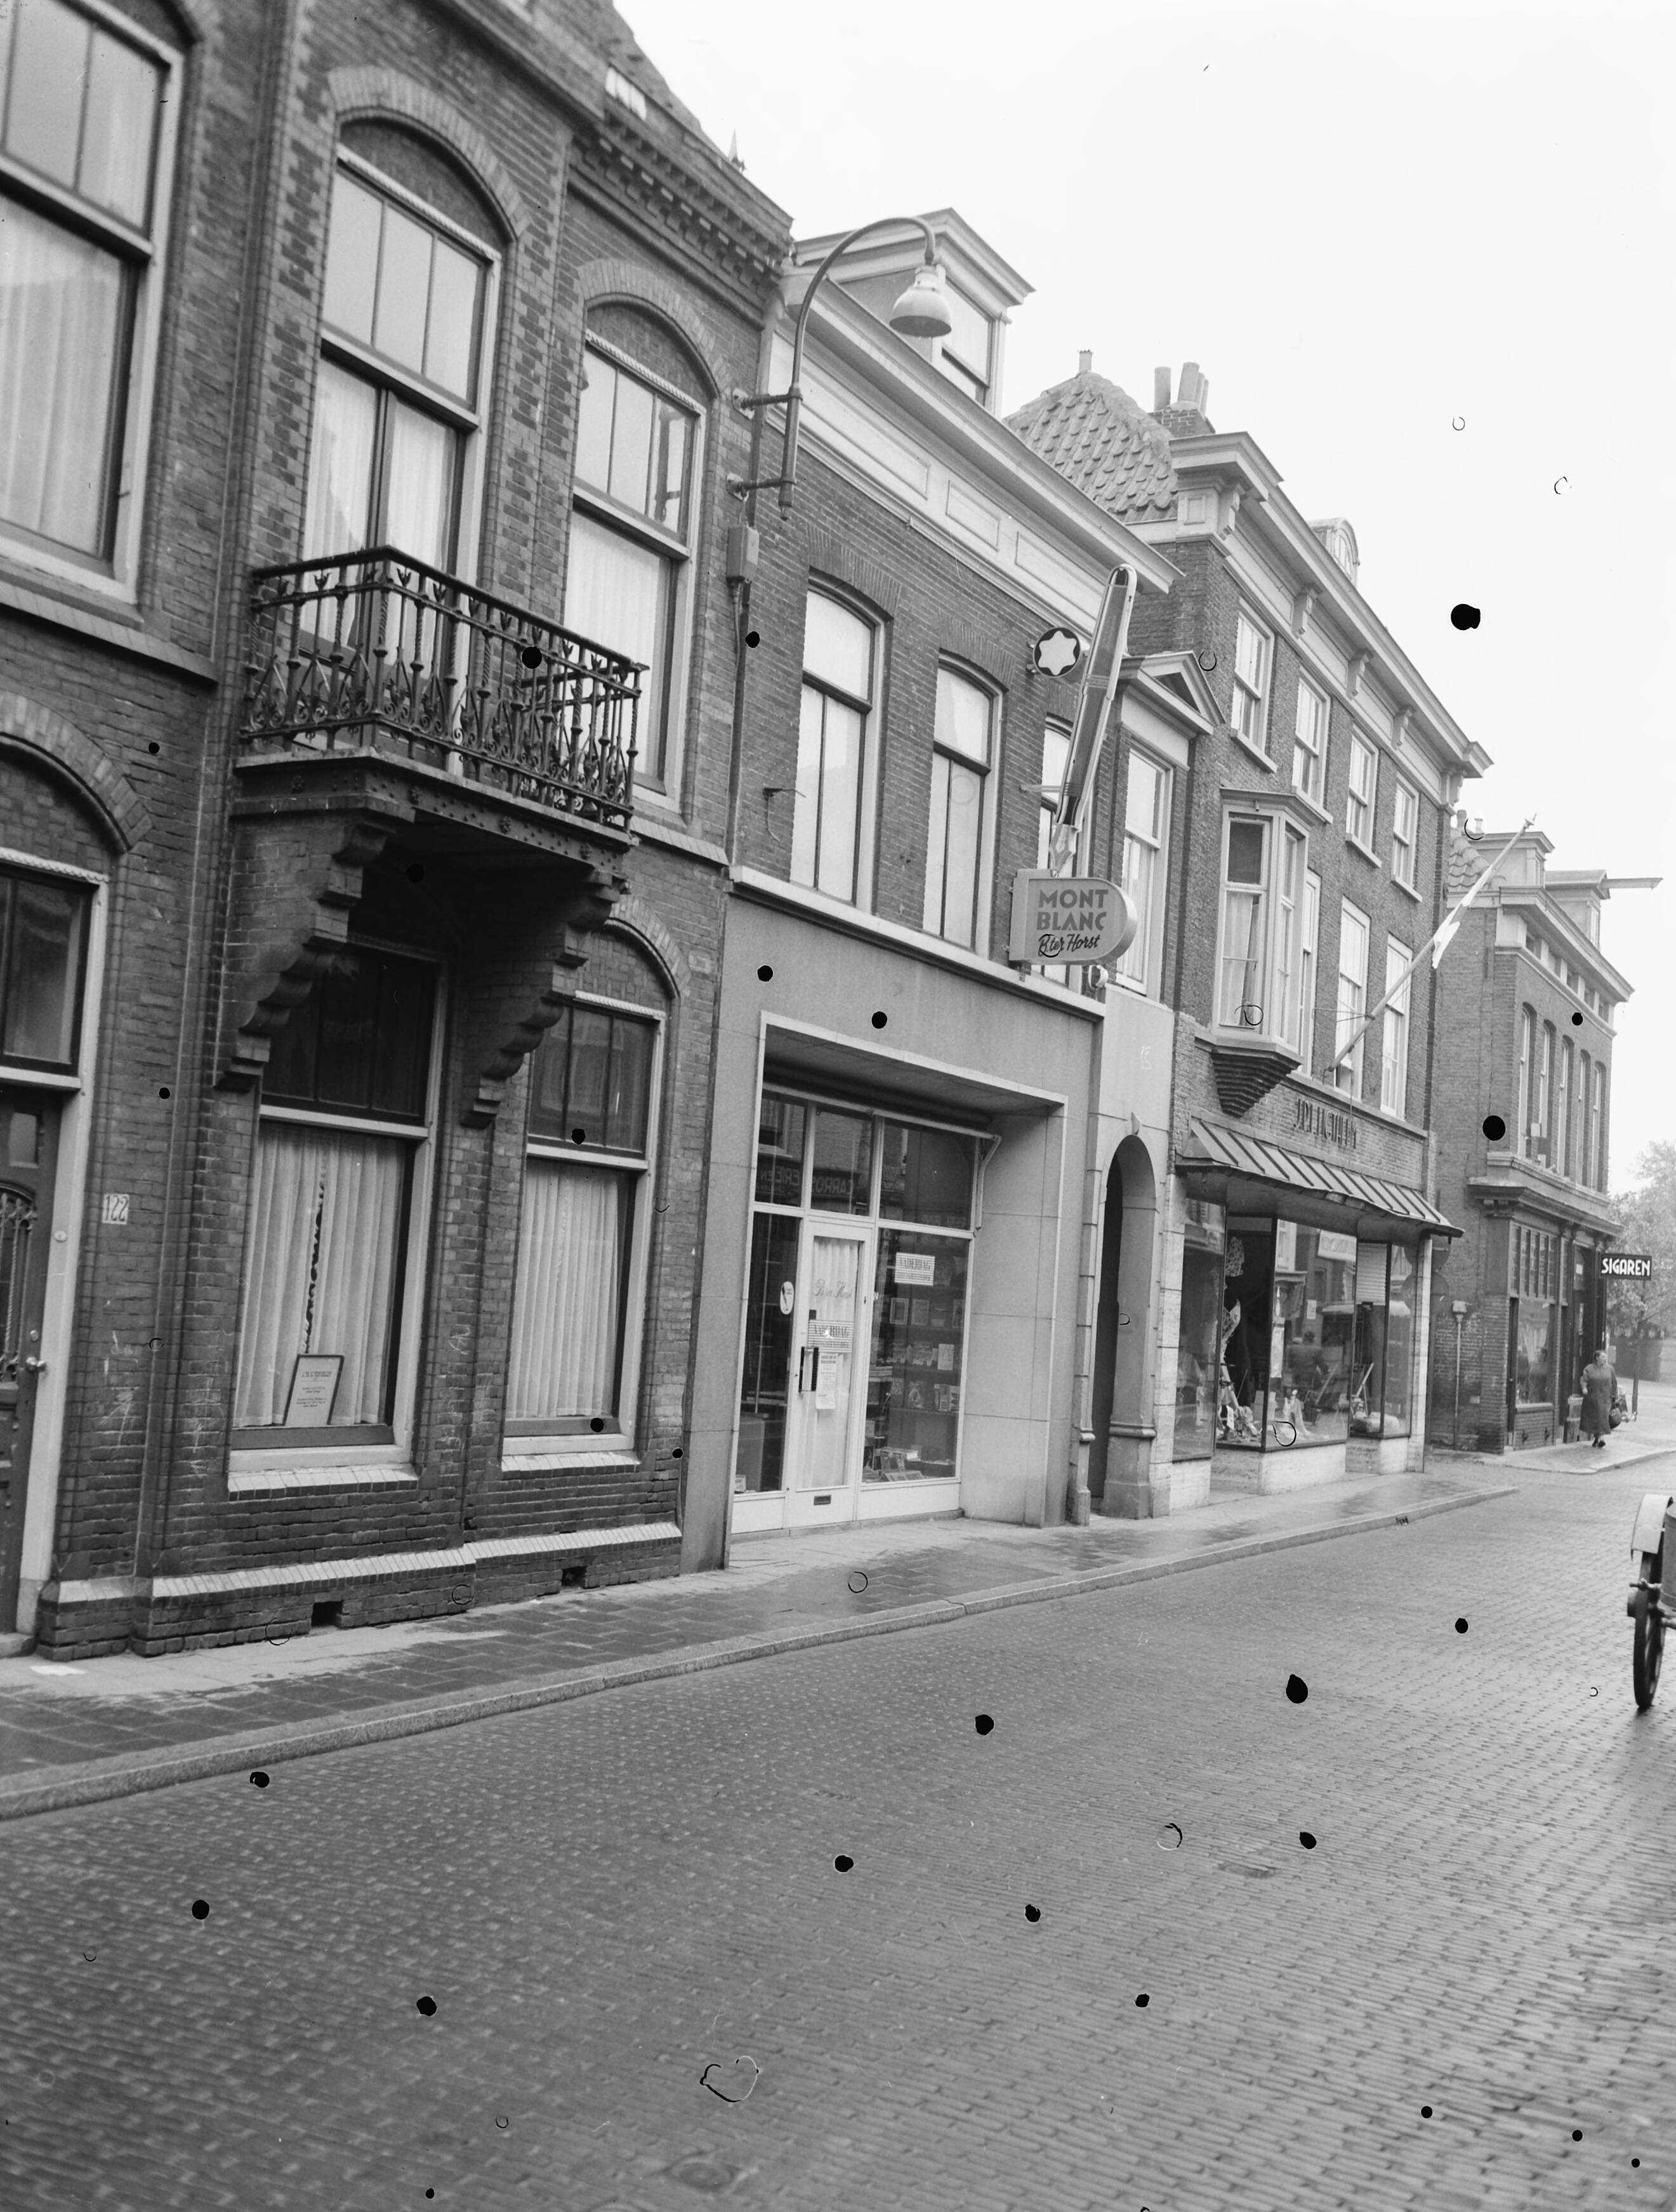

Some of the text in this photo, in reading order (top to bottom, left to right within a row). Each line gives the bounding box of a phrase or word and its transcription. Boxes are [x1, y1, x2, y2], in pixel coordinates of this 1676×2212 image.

[1038, 889, 1109, 908] MONT
[1036, 911, 1107, 931] BLANC
[1067, 933, 1100, 952] Horst
[105, 1195, 128, 1221] 122
[1601, 1258, 1651, 1276] SIGAREN
